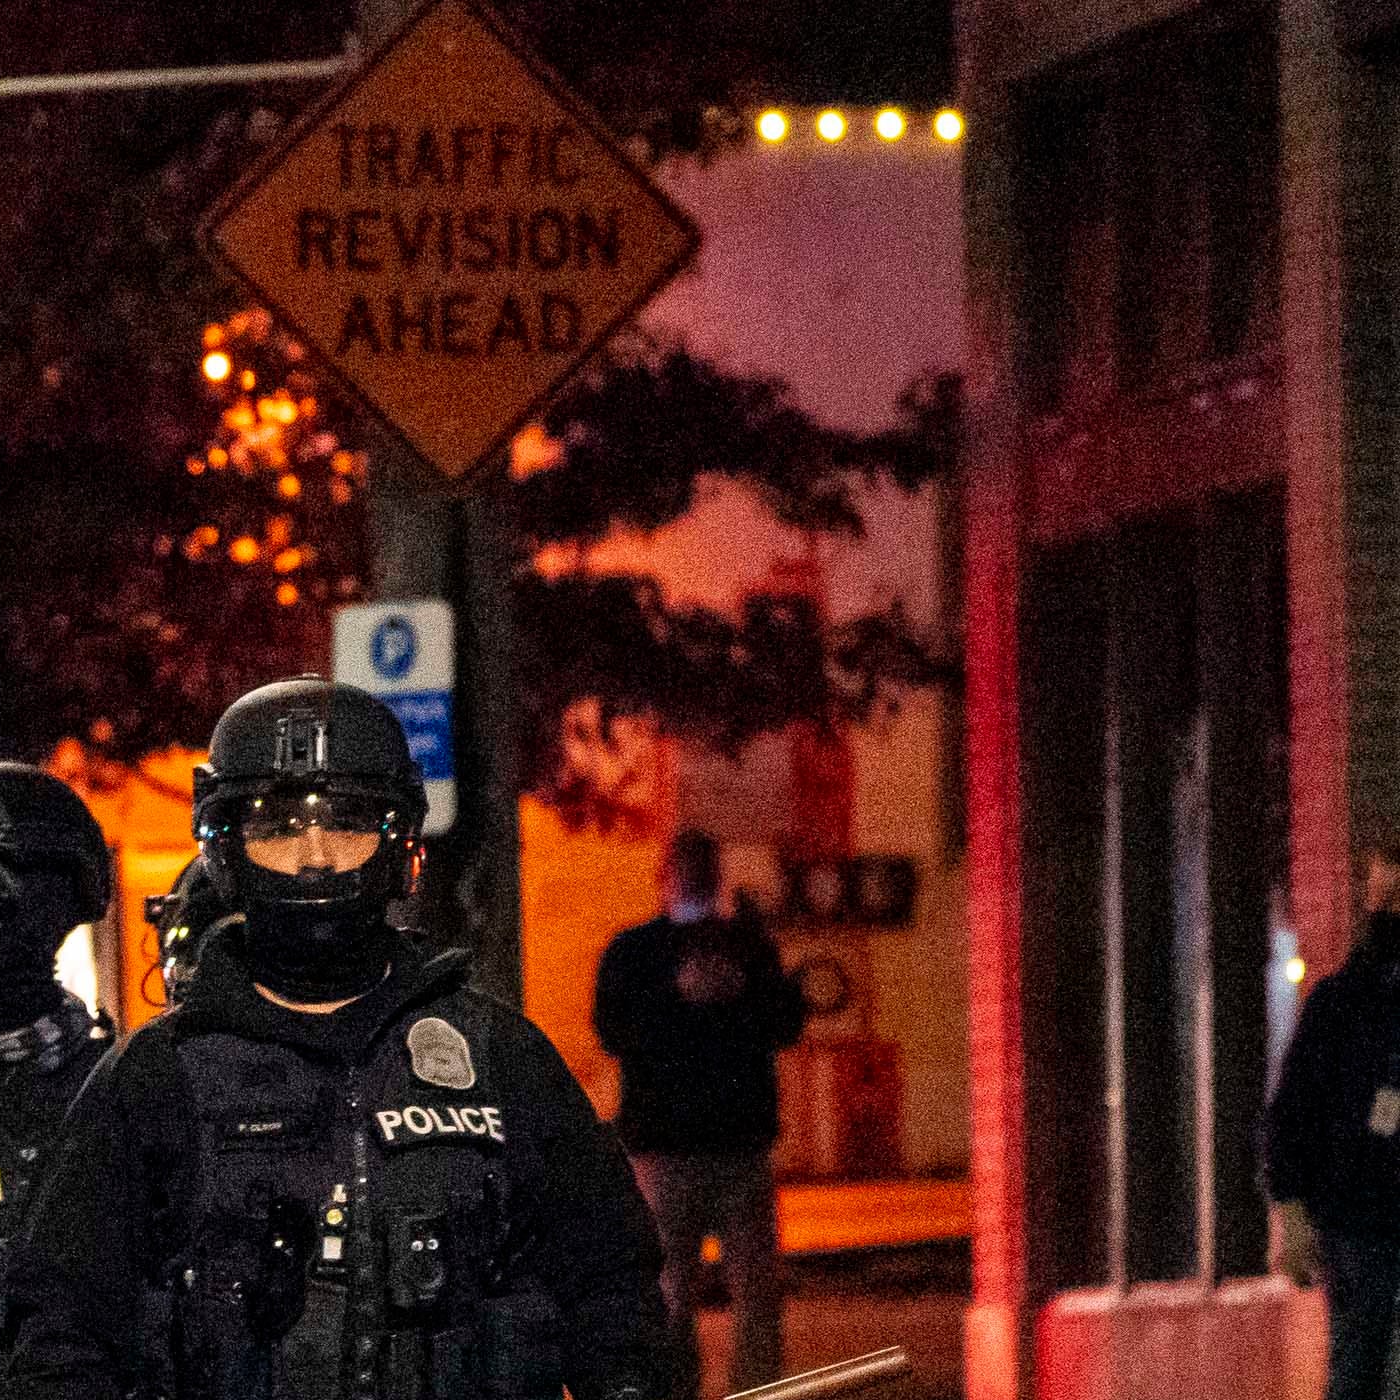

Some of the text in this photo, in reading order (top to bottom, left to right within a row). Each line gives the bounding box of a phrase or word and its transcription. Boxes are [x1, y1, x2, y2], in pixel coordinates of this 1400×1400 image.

[331, 123, 582, 190] TRAFFIC
[295, 206, 622, 273] REVISION
[336, 293, 583, 357] AHEAD
[375, 1104, 505, 1142] POLICE
